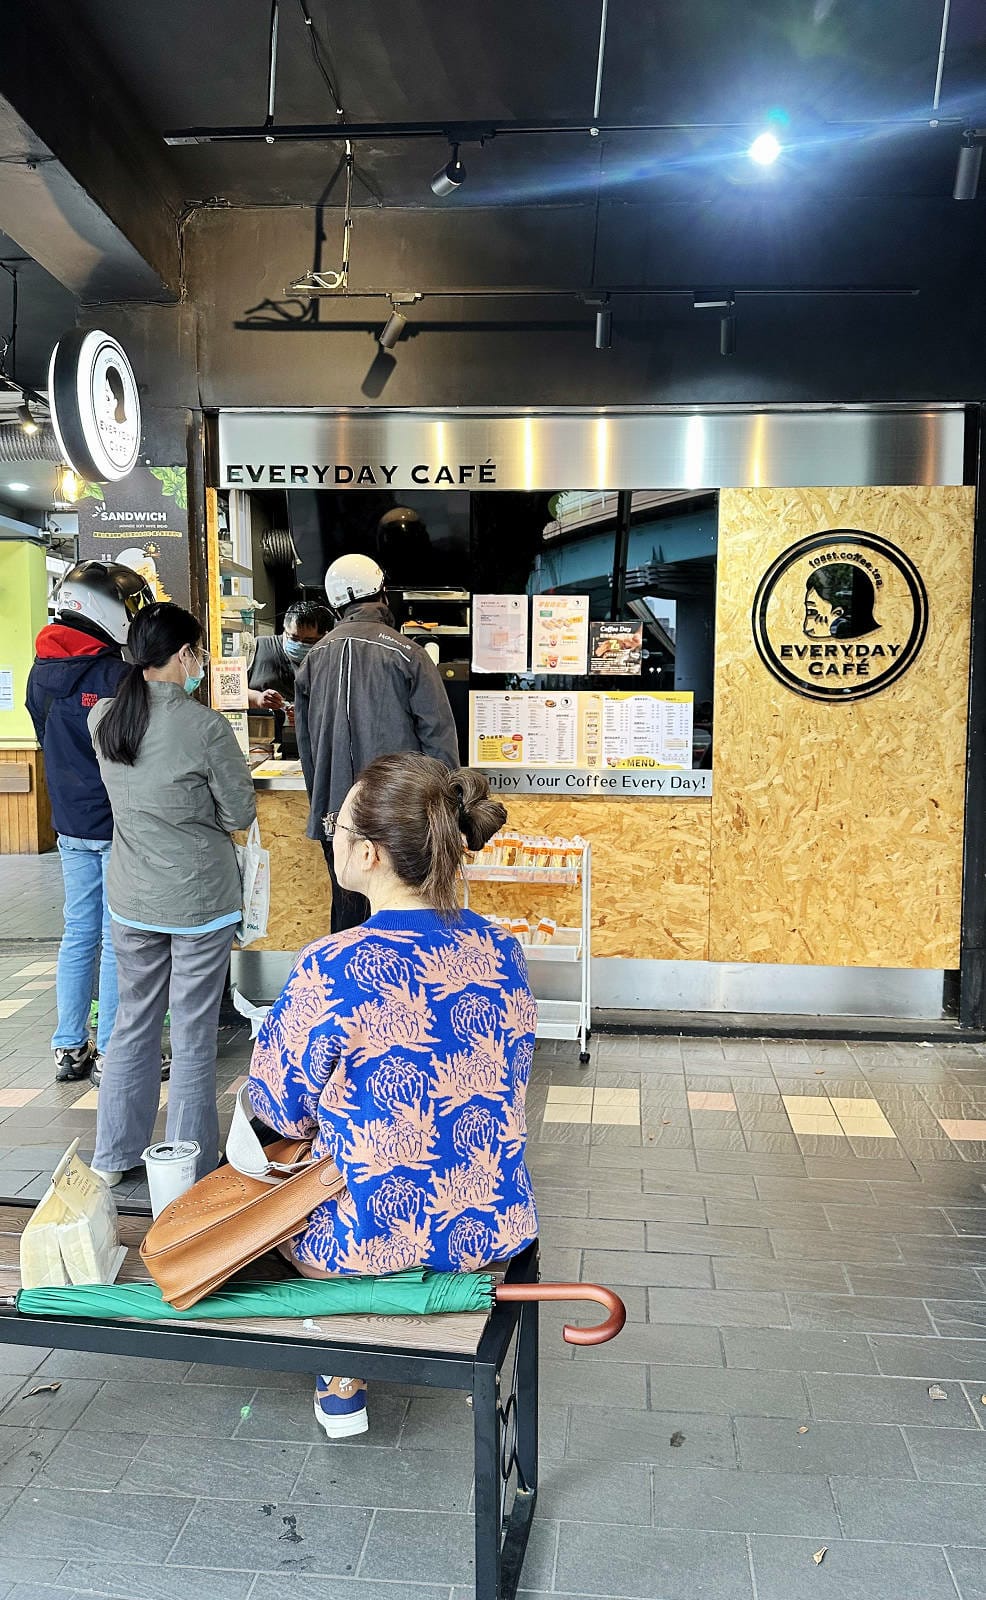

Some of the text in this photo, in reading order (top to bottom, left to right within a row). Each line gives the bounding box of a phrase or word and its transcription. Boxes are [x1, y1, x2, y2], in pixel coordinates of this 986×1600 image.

[226, 458, 497, 484] EVERYDAY CAFÉ
[101, 512, 167, 521] SANDWICH
[780, 644, 901, 658] EVERYDAY
[808, 657, 870, 676] CAFÉ
[627, 759, 656, 767] MENU
[482, 773, 706, 792] njoy Your Coffee Every Day!
